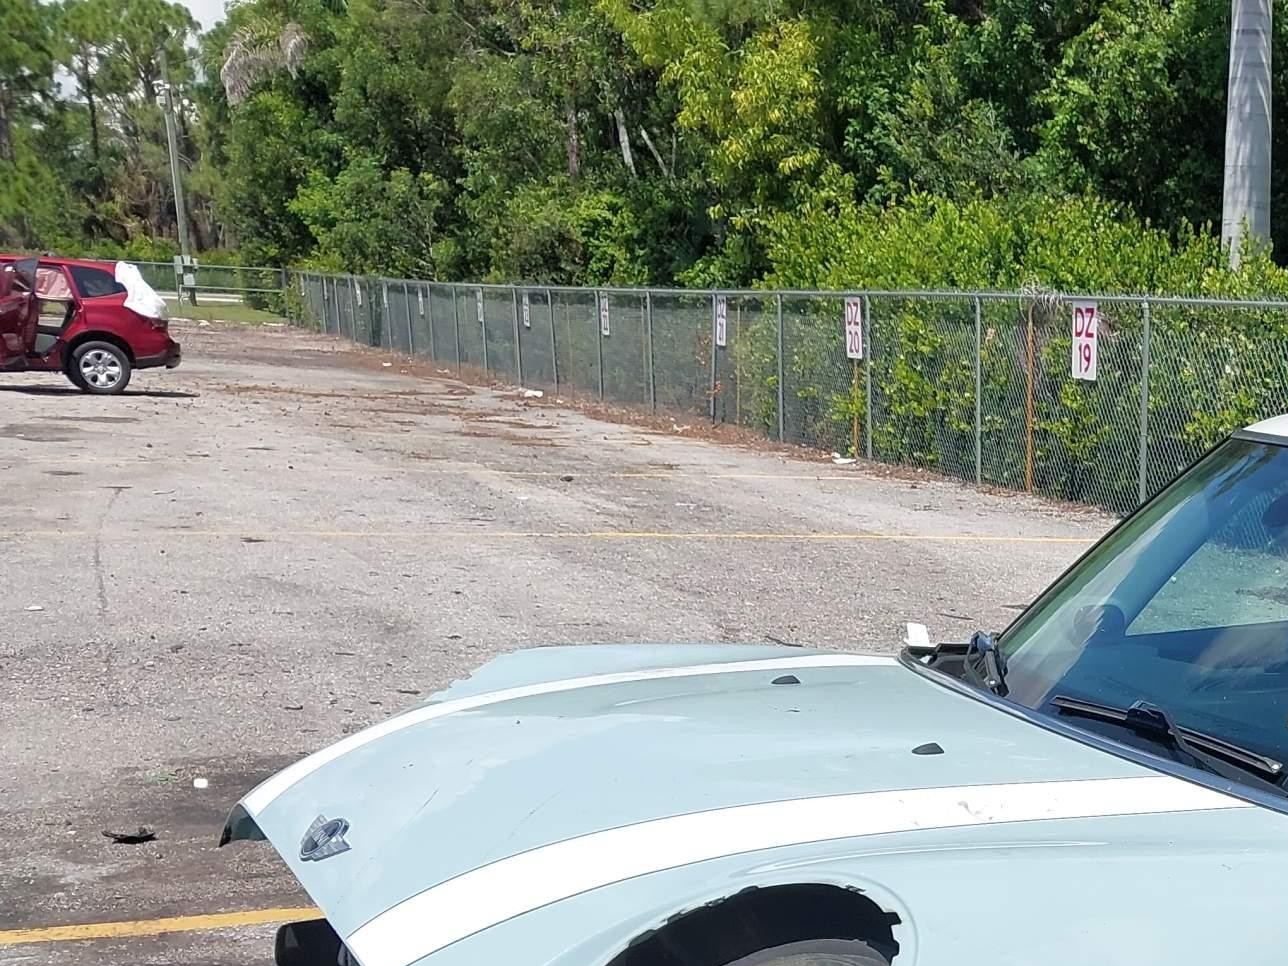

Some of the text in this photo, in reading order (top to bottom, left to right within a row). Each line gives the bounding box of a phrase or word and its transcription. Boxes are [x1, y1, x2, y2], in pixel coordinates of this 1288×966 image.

[847, 302, 859, 326] DZ
[1075, 308, 1094, 337] DZ
[849, 330, 860, 353] 20
[1078, 343, 1091, 372] 19
